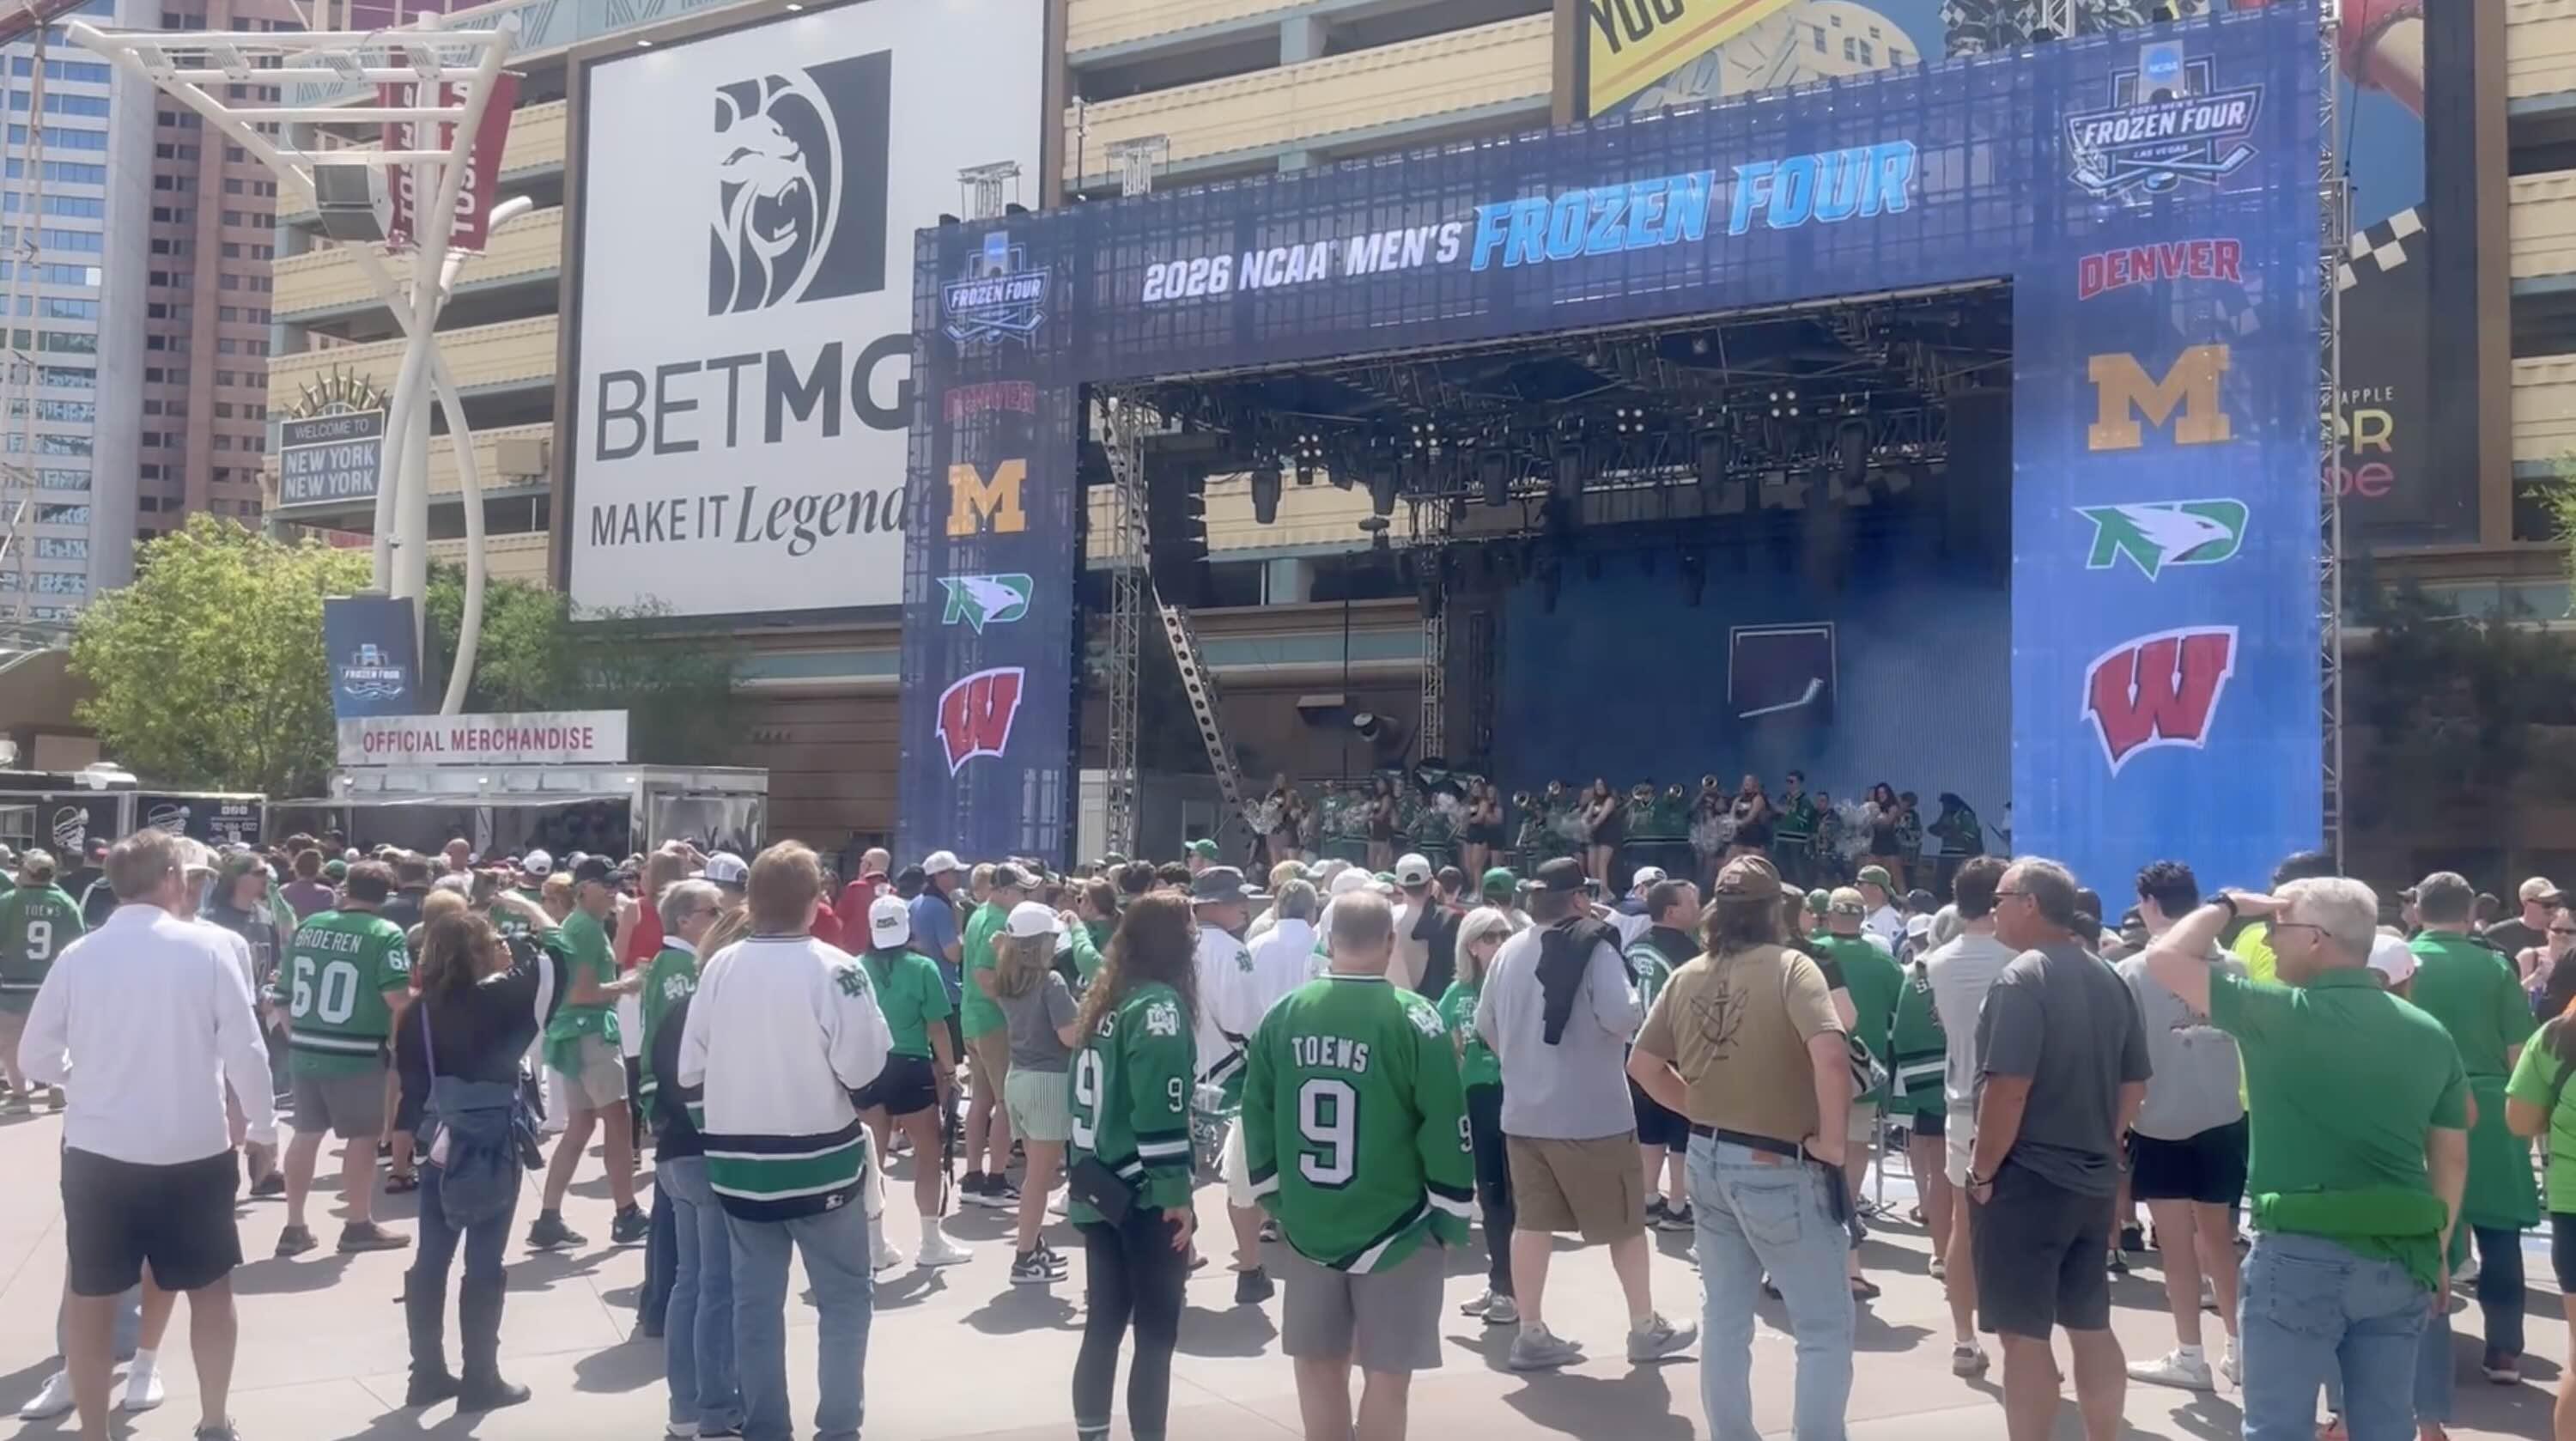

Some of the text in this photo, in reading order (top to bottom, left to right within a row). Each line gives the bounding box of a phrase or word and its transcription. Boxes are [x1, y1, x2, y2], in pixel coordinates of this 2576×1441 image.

[2083, 100, 2246, 147] FROZEN FOUR
[1142, 253, 1232, 302] 2026
[1346, 222, 1462, 277] MEN'S
[1469, 169, 1716, 272] FROZEN
[1728, 139, 1918, 236] FOUR
[951, 283, 1004, 308] FROZEN
[1005, 278, 1042, 301] FOUR
[2079, 237, 2243, 301] DENVER
[596, 333, 915, 462] BETMG
[2087, 344, 2231, 451] M
[2341, 386, 2394, 404] APPLE
[295, 418, 369, 440] WELCOME TO
[286, 443, 375, 475] NEW YORK
[284, 469, 374, 499] NEW YORK
[946, 458, 1027, 536] M
[591, 497, 688, 547] MAKE
[697, 495, 730, 539] IT
[935, 666, 1025, 777] W
[2080, 625, 2239, 779] W
[363, 727, 593, 753] OFFICIAL MERCHANDISE
[26, 920, 52, 960] 9
[290, 955, 360, 1025] 60
[1291, 1035, 1371, 1073] TOEWS
[1073, 1048, 1103, 1150] 9
[1168, 1077, 1183, 1112] 9
[1298, 1078, 1358, 1187] 9
[1458, 1116, 1473, 1152] 9
